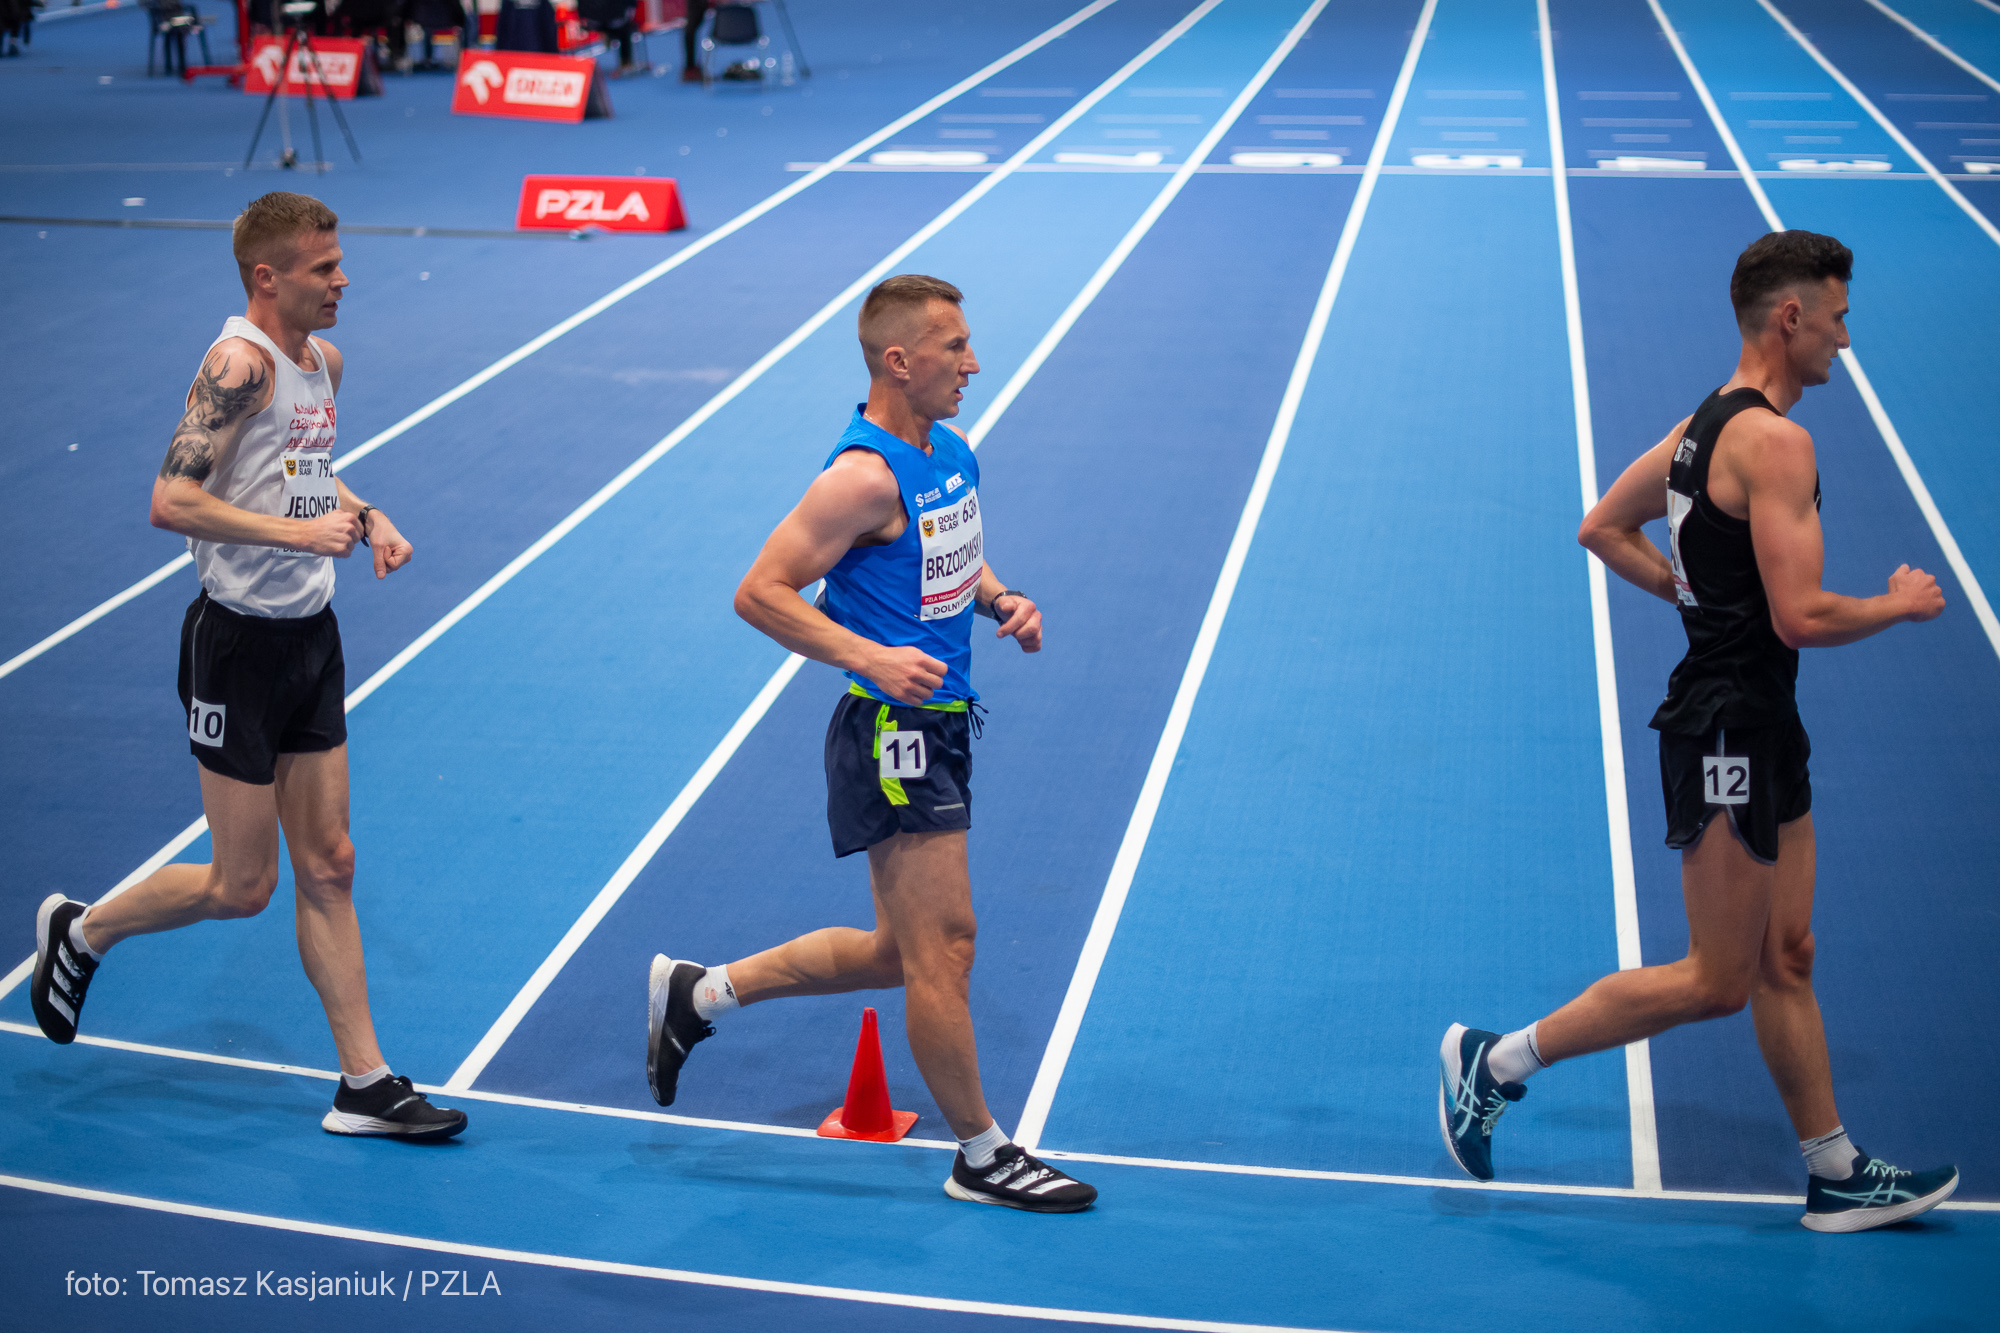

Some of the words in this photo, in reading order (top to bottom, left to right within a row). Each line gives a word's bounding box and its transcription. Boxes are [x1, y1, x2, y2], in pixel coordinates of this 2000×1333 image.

[535, 188, 650, 222] PZLA
[299, 460, 313, 468] DOLNY
[284, 496, 338, 519] JELONEK
[926, 531, 982, 581] BRZOZOWSKI
[924, 596, 938, 604] PZLA
[933, 600, 960, 615] DOLNY
[191, 706, 224, 740] 10
[886, 738, 922, 770] 11
[1706, 764, 1748, 797] 12
